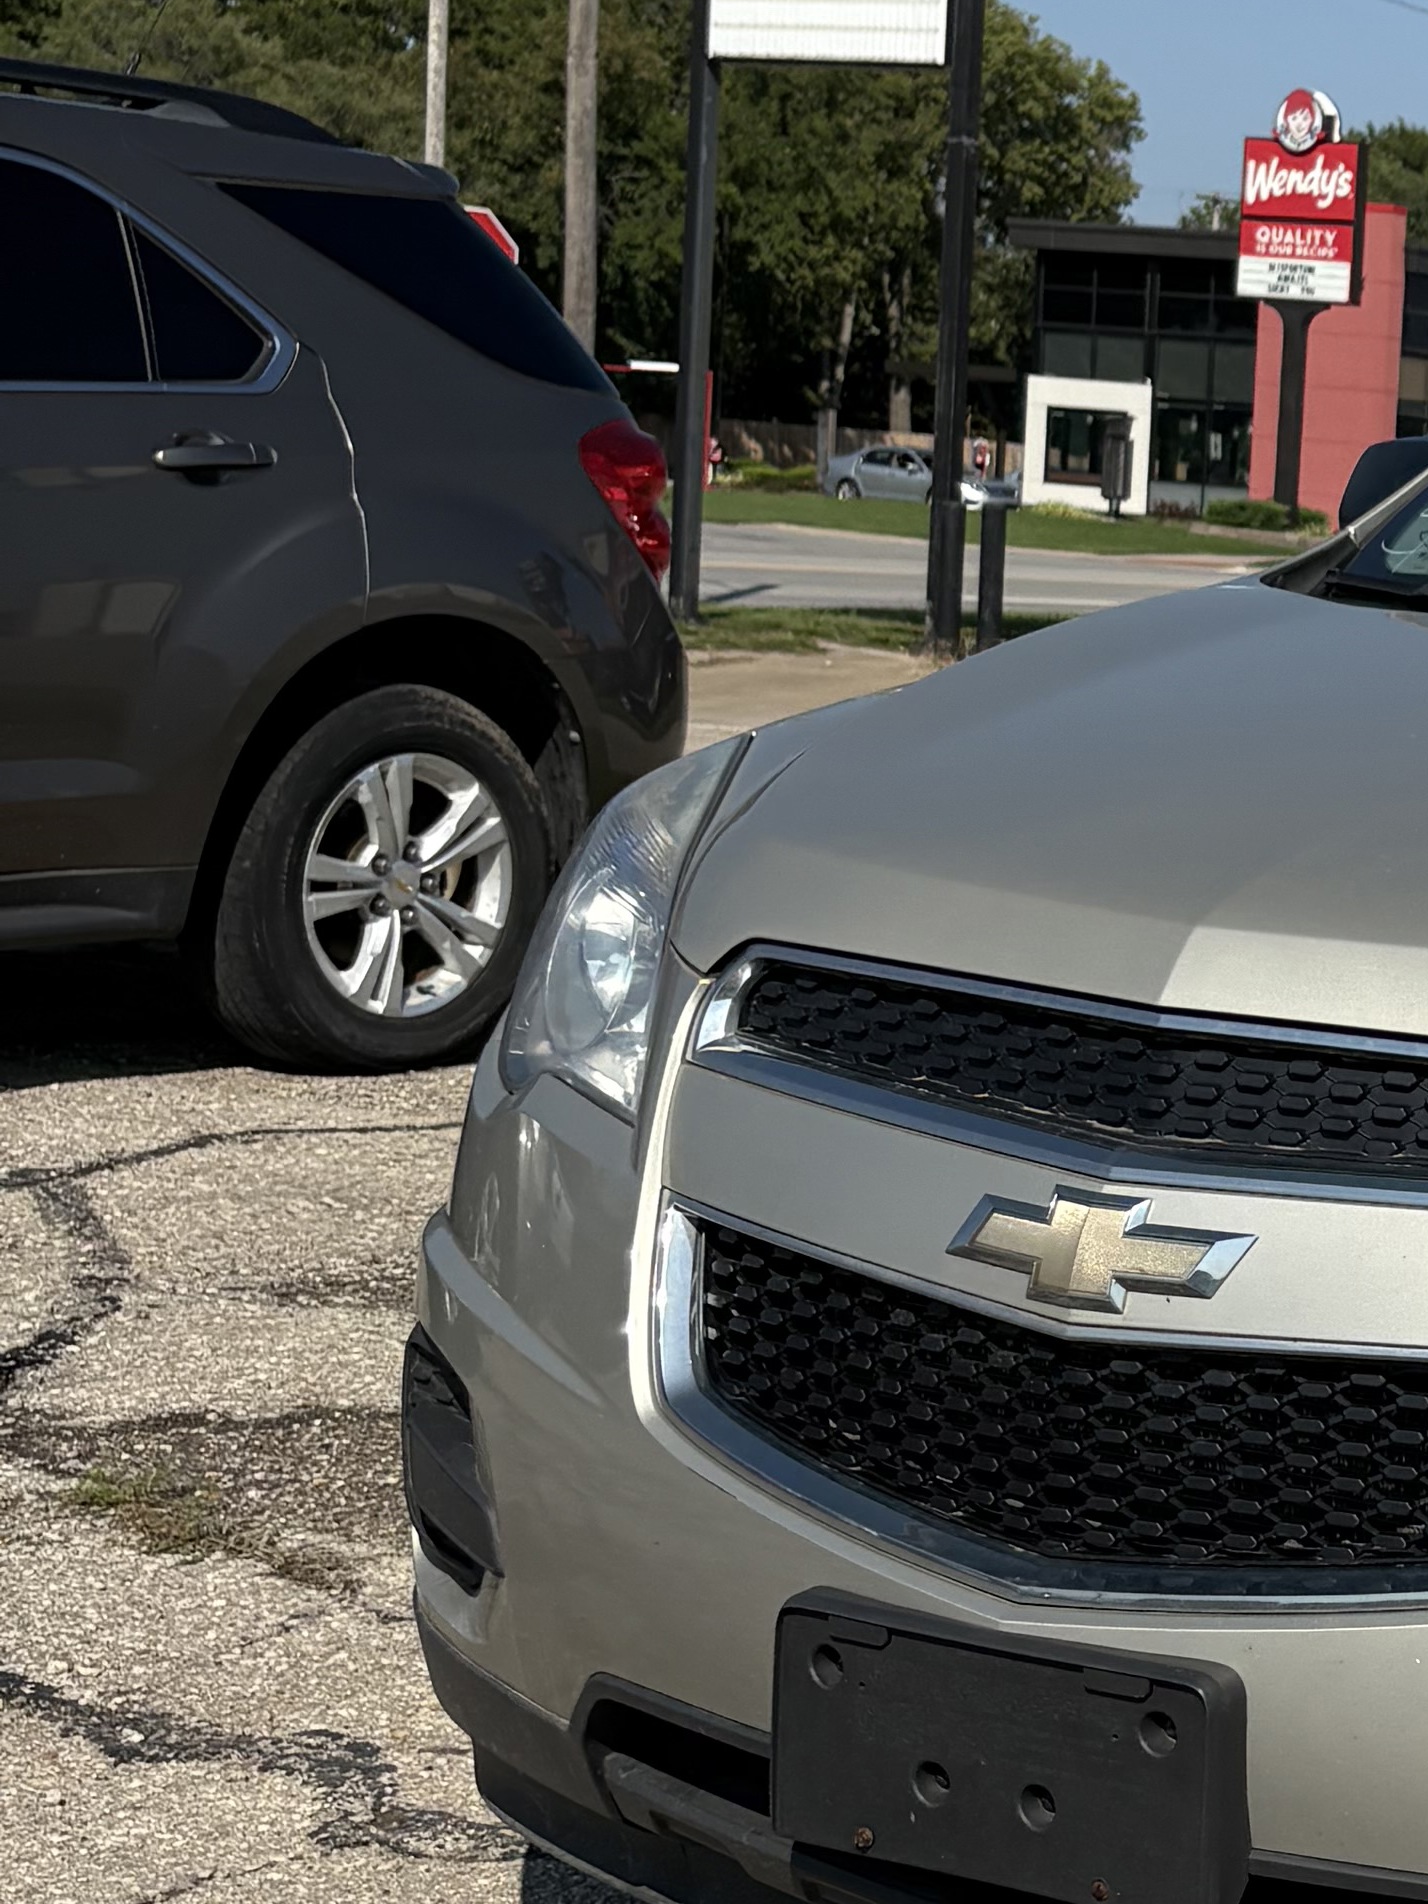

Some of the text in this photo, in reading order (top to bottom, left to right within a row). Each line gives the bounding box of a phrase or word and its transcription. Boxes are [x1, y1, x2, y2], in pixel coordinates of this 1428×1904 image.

[1245, 154, 1353, 209] Wendy's
[1255, 225, 1337, 247] QUALITY
[1268, 244, 1293, 256] OUR
